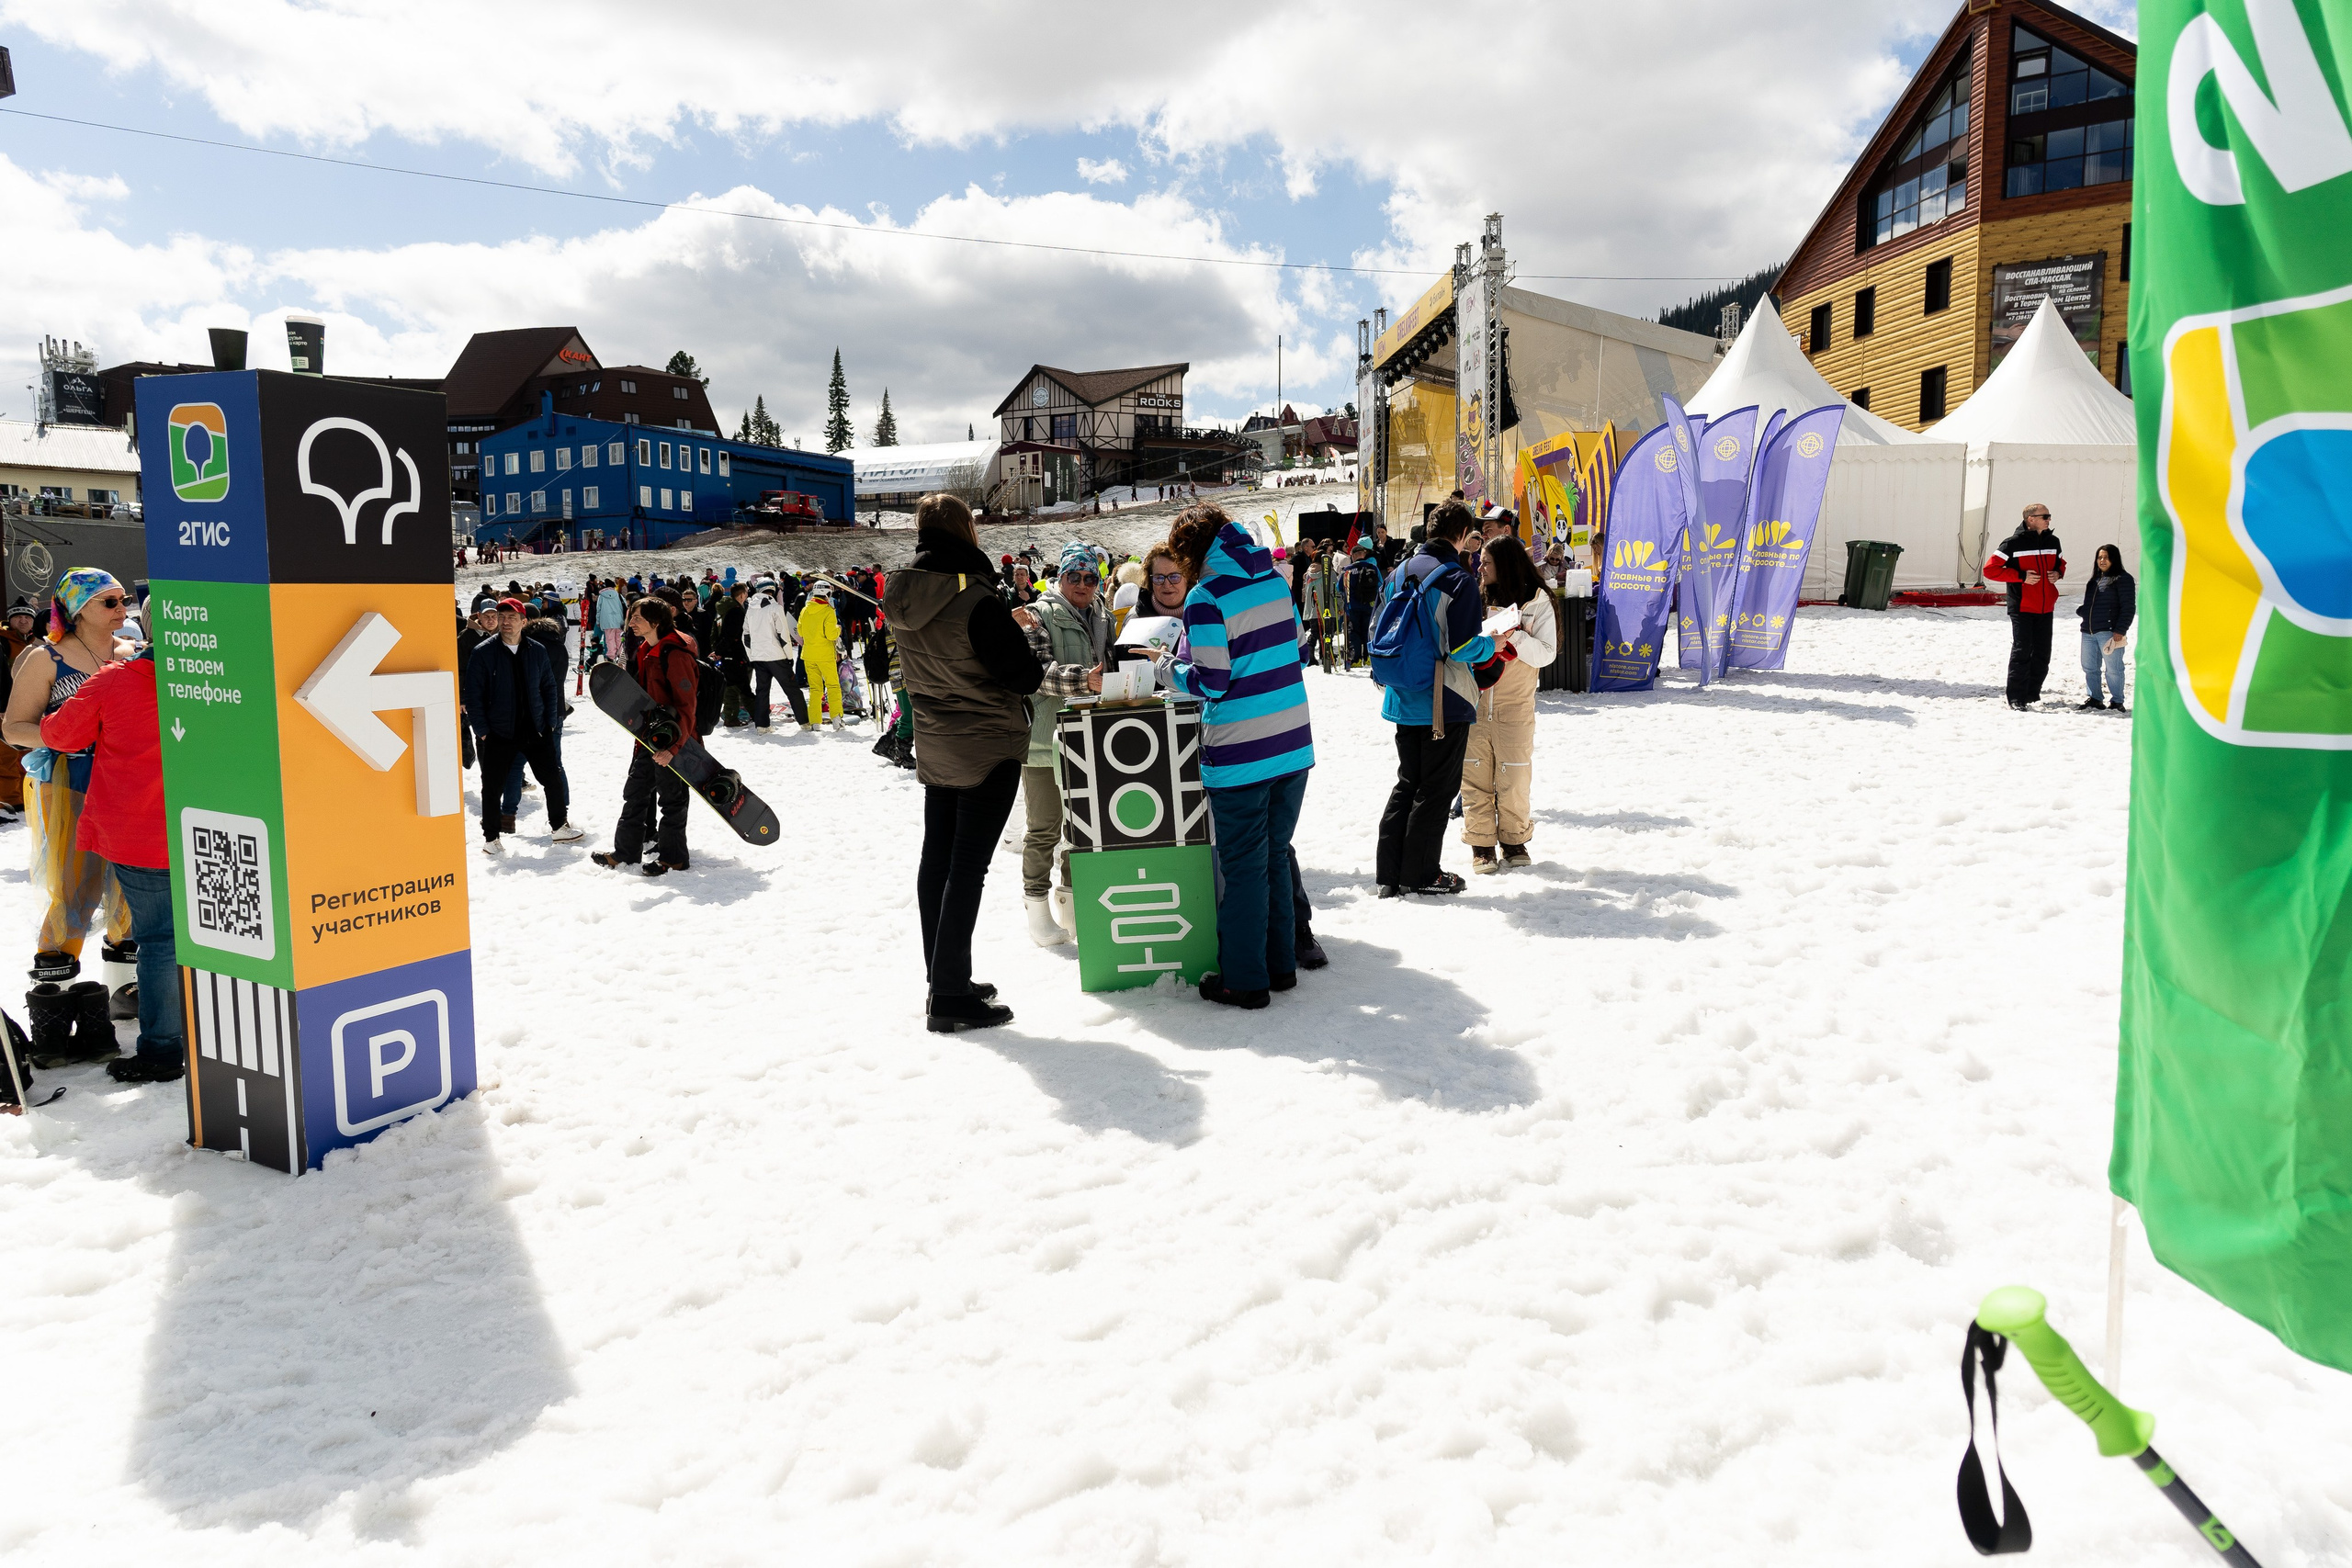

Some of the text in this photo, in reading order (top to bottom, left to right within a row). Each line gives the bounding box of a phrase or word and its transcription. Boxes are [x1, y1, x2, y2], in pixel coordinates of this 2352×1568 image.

[2006, 261, 2093, 279] ВОССТАНАВЛИВАЮЩИЙ
[2025, 274, 2072, 285] СПА-МАССАЖ
[2067, 285, 2089, 293] склоне?
[2065, 294, 2091, 302] Центре
[63, 384, 93, 393] ОЛЬГА
[1140, 398, 1181, 407] ROOKS
[178, 522, 230, 547] 2ГИС
[1752, 549, 1787, 558] Главные
[1752, 559, 1785, 568] красоте
[1611, 571, 1667, 583] Главные по
[1609, 581, 1651, 592] красоте
[163, 600, 208, 625] Карта
[164, 631, 217, 651] города
[166, 658, 224, 675] в твоем
[167, 680, 242, 705] телефоне
[311, 873, 455, 913] Регистрация
[311, 899, 441, 944] участников
[39, 968, 70, 976] DALBELLO
[368, 1029, 416, 1099] P
